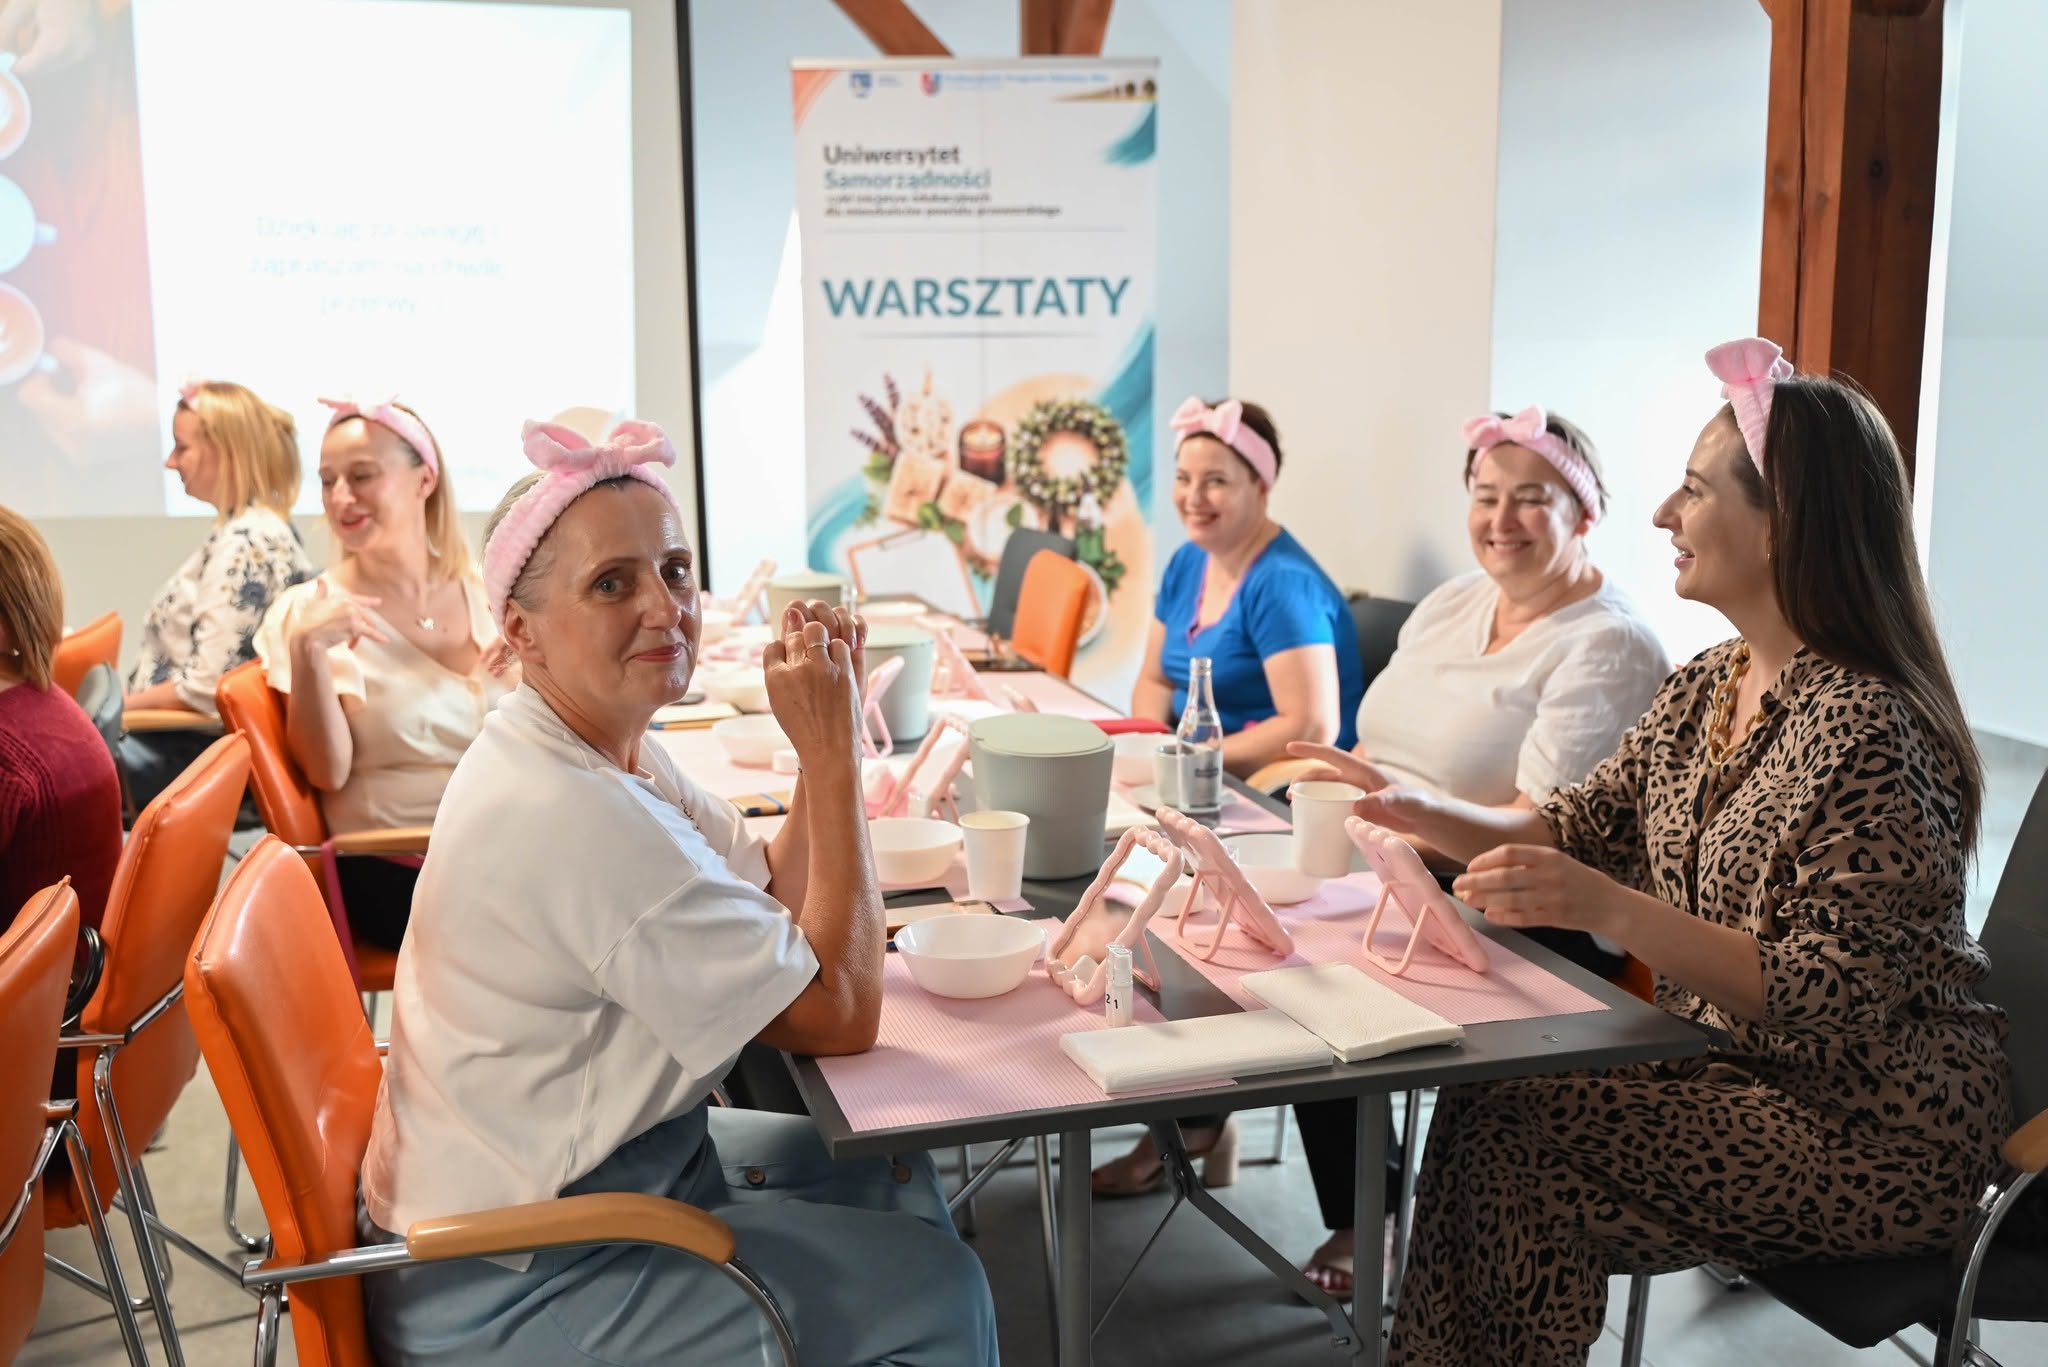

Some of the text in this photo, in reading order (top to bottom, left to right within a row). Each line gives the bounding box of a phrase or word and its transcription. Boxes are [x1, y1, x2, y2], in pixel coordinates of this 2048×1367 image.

[823, 145, 961, 167] Uniwersytet
[824, 167, 992, 190] Samorządności
[821, 276, 1131, 318] WARSZTATY
[1105, 993, 1111, 1004] 2
[1113, 999, 1119, 1009] 1
